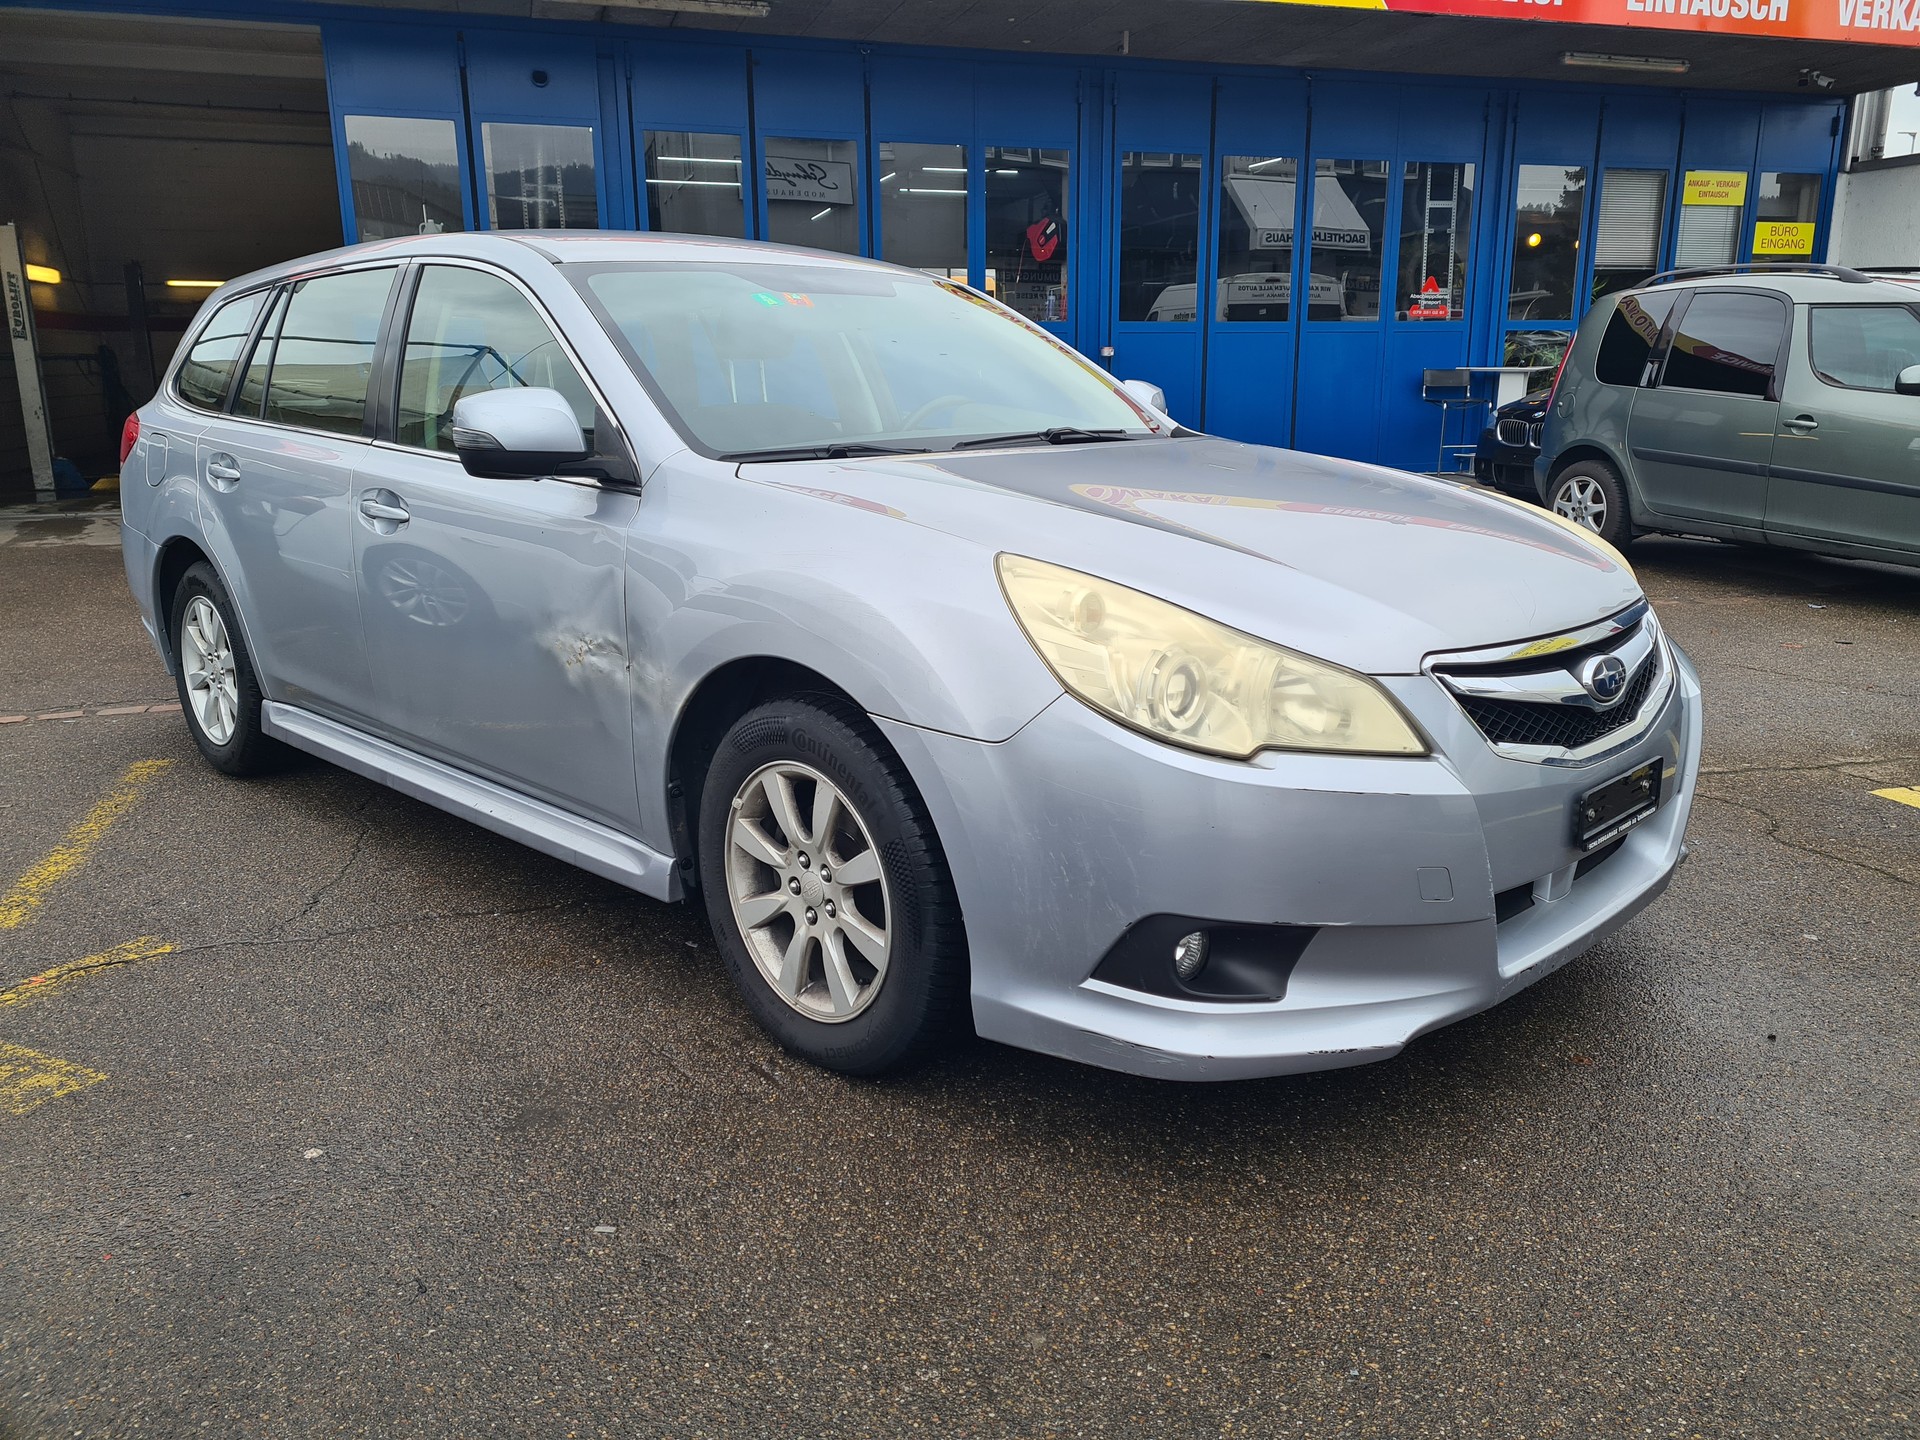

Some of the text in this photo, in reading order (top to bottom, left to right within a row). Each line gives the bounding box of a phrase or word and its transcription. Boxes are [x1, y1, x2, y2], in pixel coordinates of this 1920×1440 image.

[1688, 180, 1711, 188] ANKAUF
[1715, 180, 1742, 188] VERKAUF
[1698, 190, 1729, 199] EINTAUSCH
[1770, 224, 1799, 237] BÜRO
[1760, 238, 1806, 250] EINGANG
[791, 727, 877, 811] Continental
